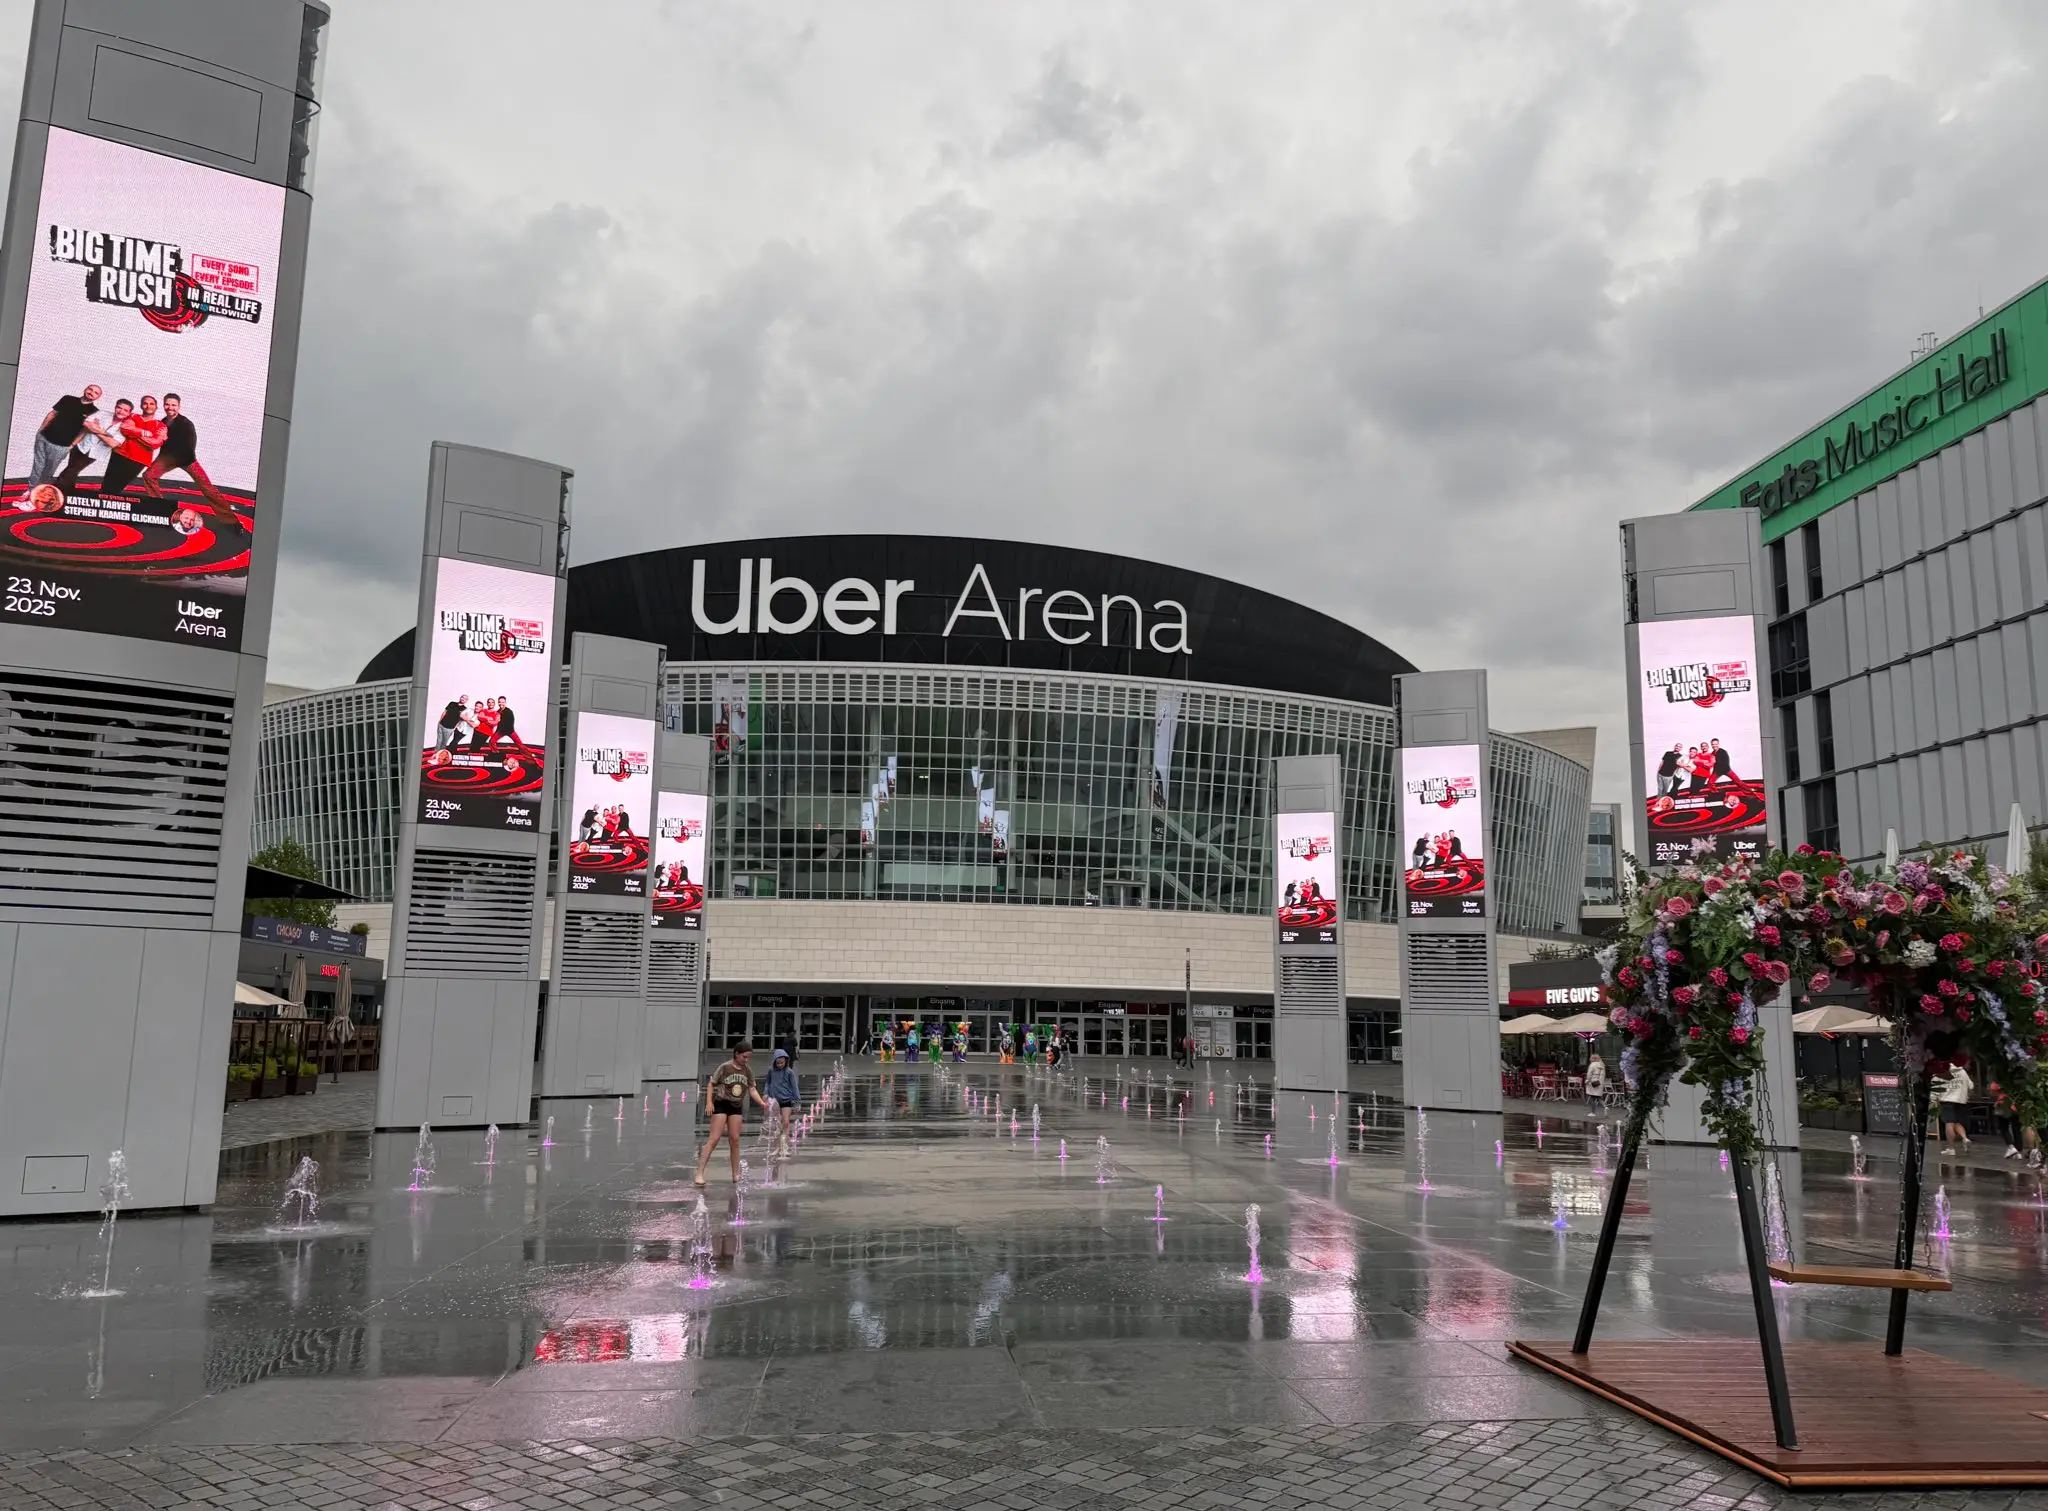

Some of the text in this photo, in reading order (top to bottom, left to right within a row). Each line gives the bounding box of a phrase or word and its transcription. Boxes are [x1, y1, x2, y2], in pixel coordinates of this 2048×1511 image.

[57, 226, 180, 278] BIG TIME
[202, 259, 249, 276] EVERY SONG
[100, 266, 172, 309] RUSH
[195, 272, 254, 290] EVERY EPISODE
[188, 287, 258, 314] IN REAL LIFE
[1824, 396, 1928, 481] Music
[1935, 328, 2009, 416] Hall
[66, 496, 131, 511] KATELYN TARVER
[64, 506, 170, 526] STEPHEN KRAMER GLICKMAN
[7, 576, 81, 601] 23. Nov.
[4, 595, 56, 616] 2025
[178, 600, 223, 620] Uber
[691, 558, 1193, 654] Uber Arena
[175, 618, 227, 638] Arena
[444, 612, 504, 634] BIG TIME
[466, 630, 500, 650] RUSH
[532, 640, 544, 650] LIFE
[1650, 664, 1707, 686] BIG TIME
[1672, 680, 1708, 700] RUSH
[583, 748, 598, 760] BIG
[600, 748, 622, 761] TIME
[596, 760, 620, 774] RUSH
[1409, 780, 1425, 794] BIG
[1426, 778, 1448, 792] TIME
[426, 799, 462, 811] 23. Nov.
[1423, 789, 1447, 803] RUSH
[425, 809, 450, 820] 2025
[507, 806, 530, 816] Uber
[506, 816, 532, 826] Arena
[1656, 842, 1690, 851] 23. Nov.
[1734, 841, 1756, 850] Uber
[1546, 986, 1600, 1004] FIVE GUYS
